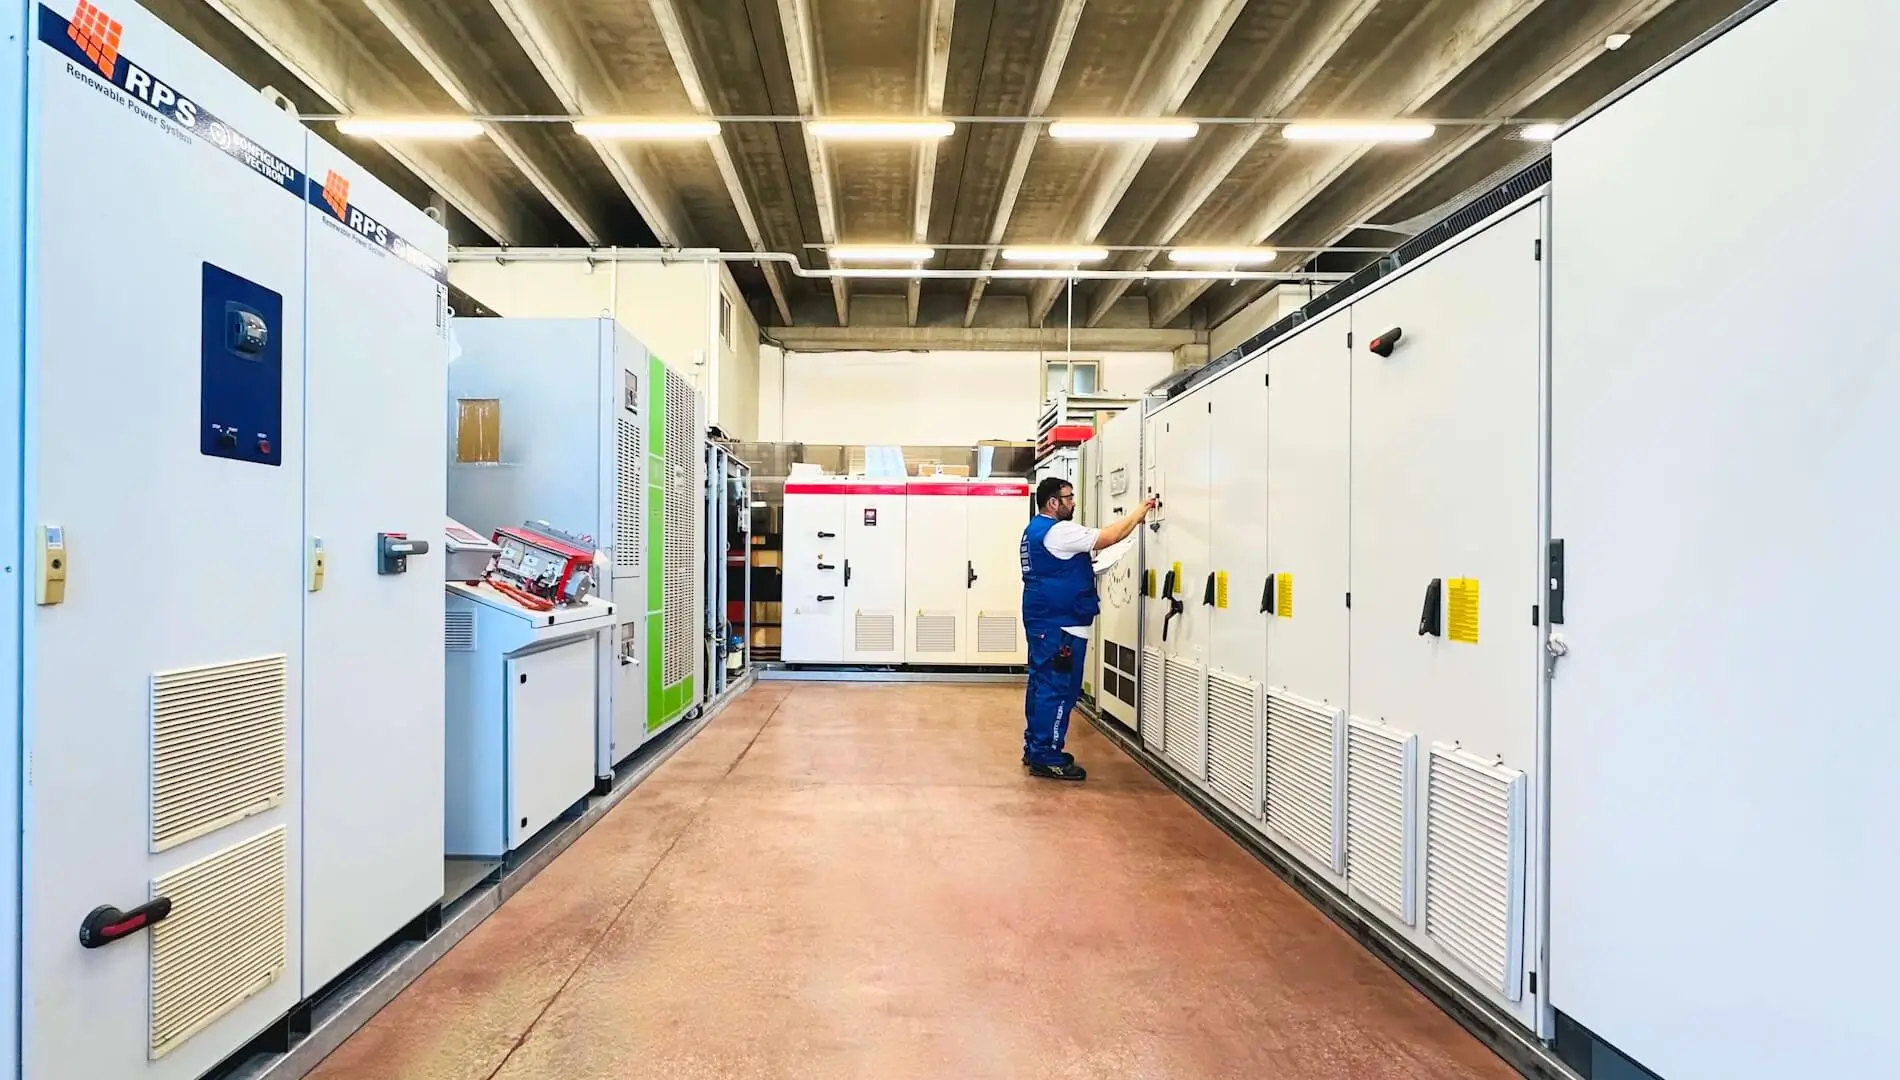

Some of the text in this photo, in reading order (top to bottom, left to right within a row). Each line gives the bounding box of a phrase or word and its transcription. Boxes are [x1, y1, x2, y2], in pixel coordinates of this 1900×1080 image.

[66, 62, 192, 145] Renewable Power System
[125, 63, 197, 127] RPS
[244, 153, 284, 185] VECTRON
[349, 207, 388, 246] RPS
